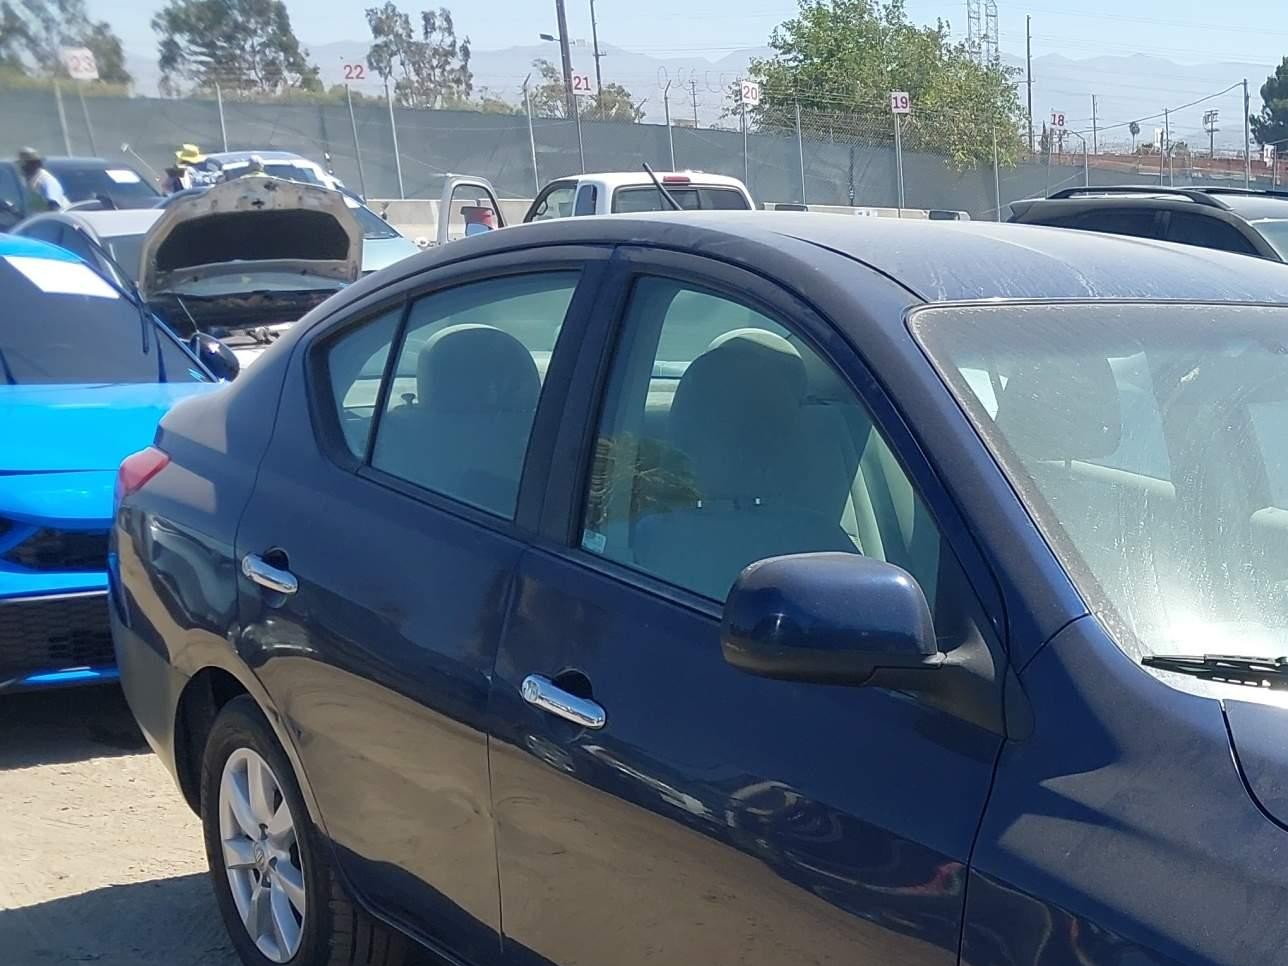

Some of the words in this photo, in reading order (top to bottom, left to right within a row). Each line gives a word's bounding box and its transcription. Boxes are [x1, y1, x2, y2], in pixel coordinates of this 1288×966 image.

[343, 64, 365, 80] 22
[573, 75, 592, 91] 21
[743, 85, 758, 101] 20
[892, 96, 908, 109] 19
[1050, 113, 1065, 127] 18
